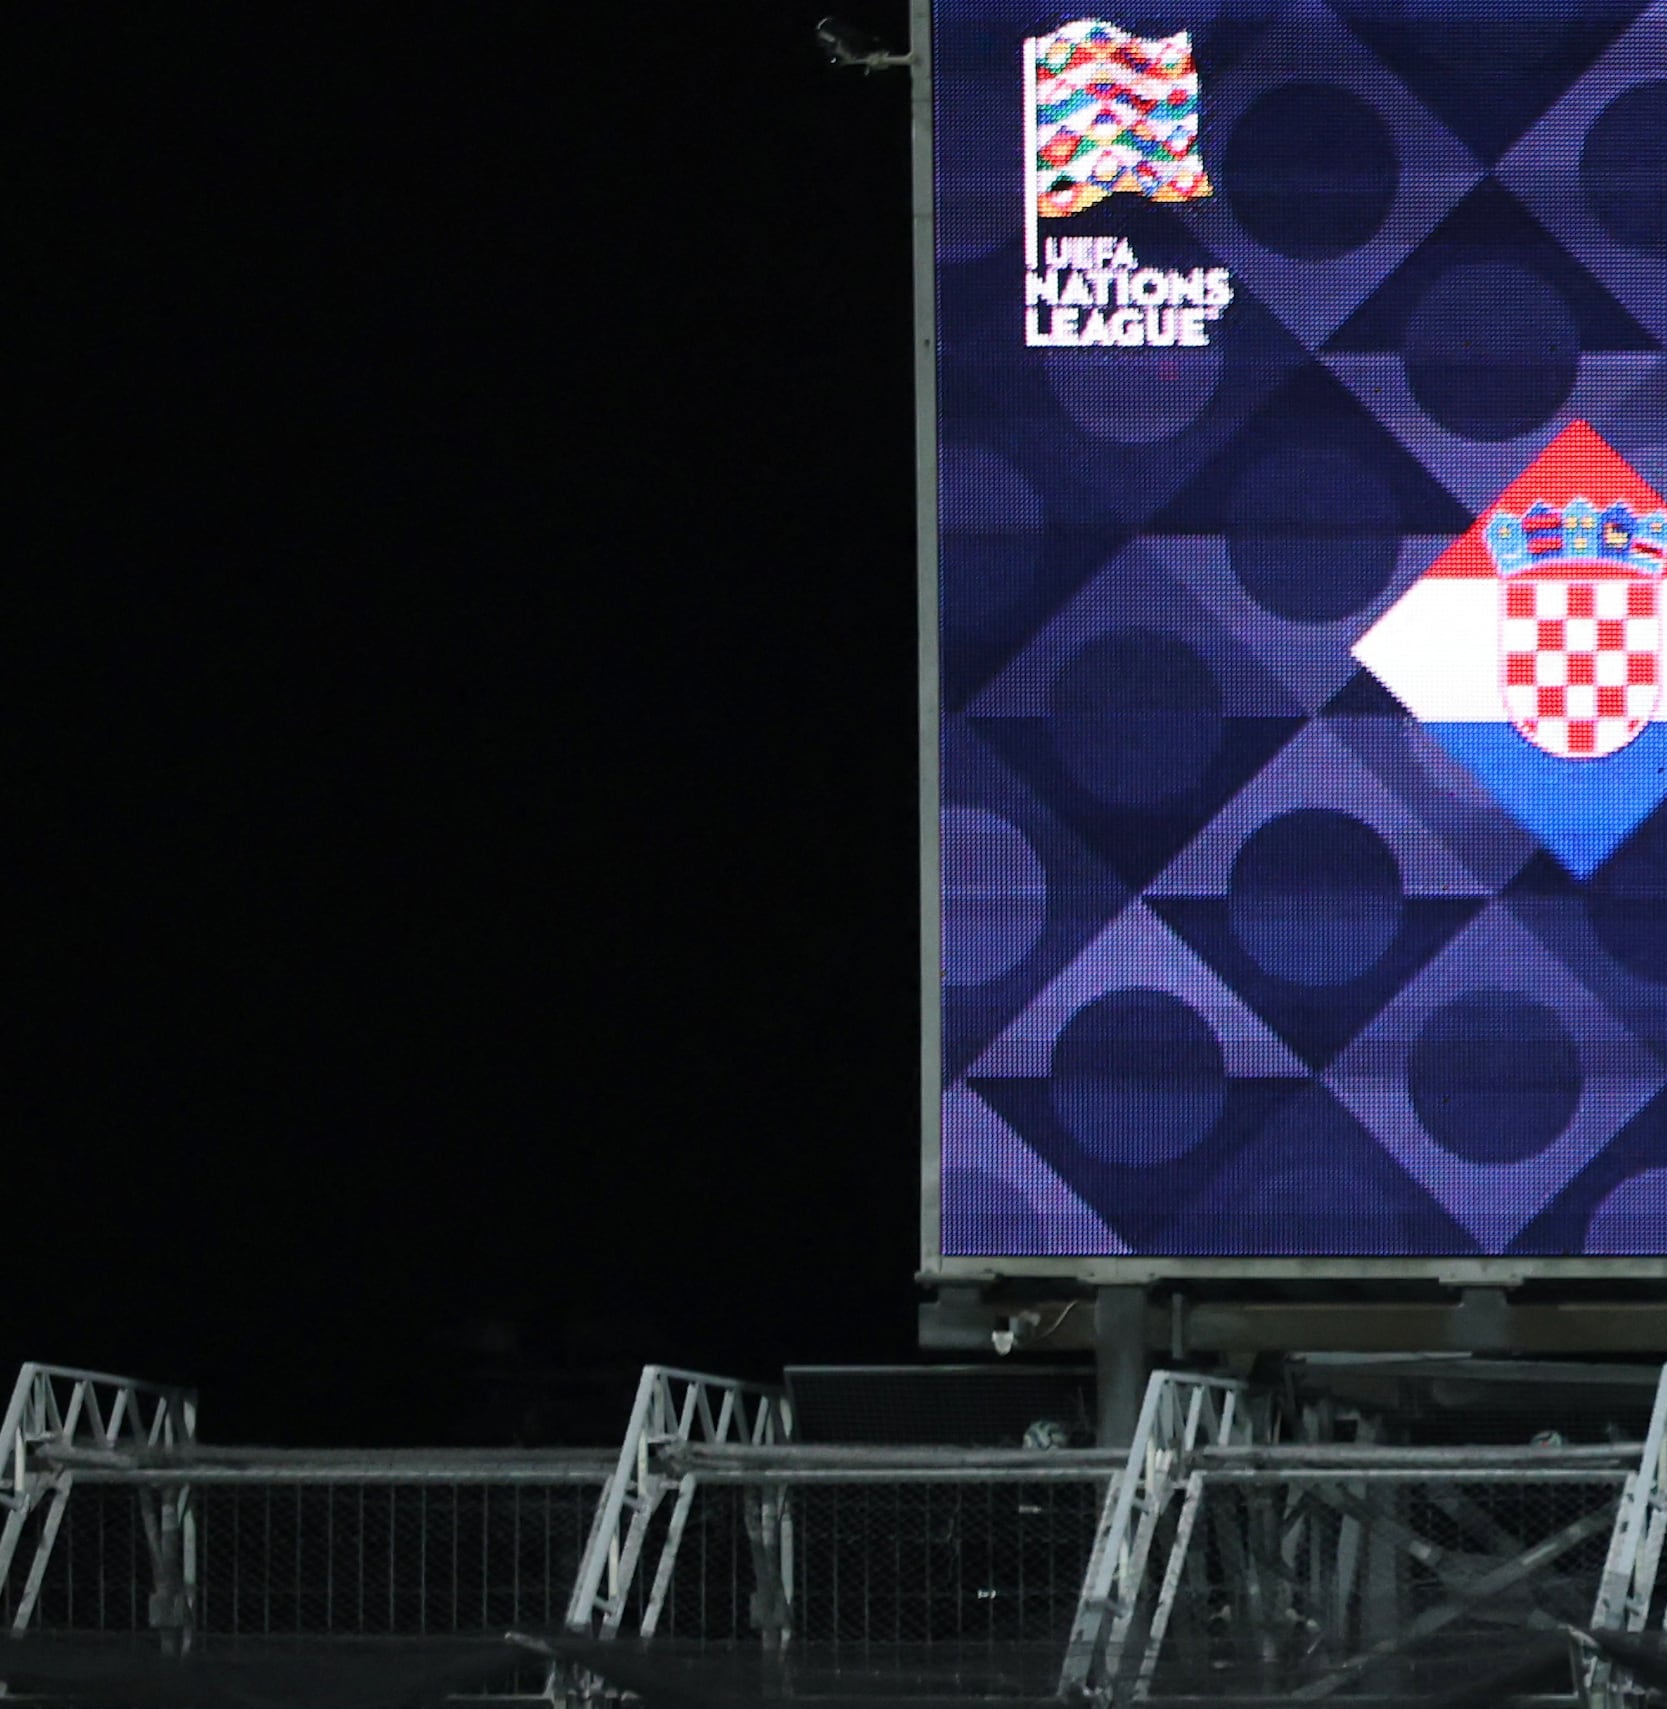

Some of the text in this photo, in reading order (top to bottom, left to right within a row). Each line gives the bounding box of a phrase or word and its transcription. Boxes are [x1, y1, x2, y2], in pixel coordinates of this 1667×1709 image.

[1045, 237, 1138, 269] UEFA
[1025, 267, 1234, 306] NATIONS
[1025, 306, 1210, 347] LEAGUE
